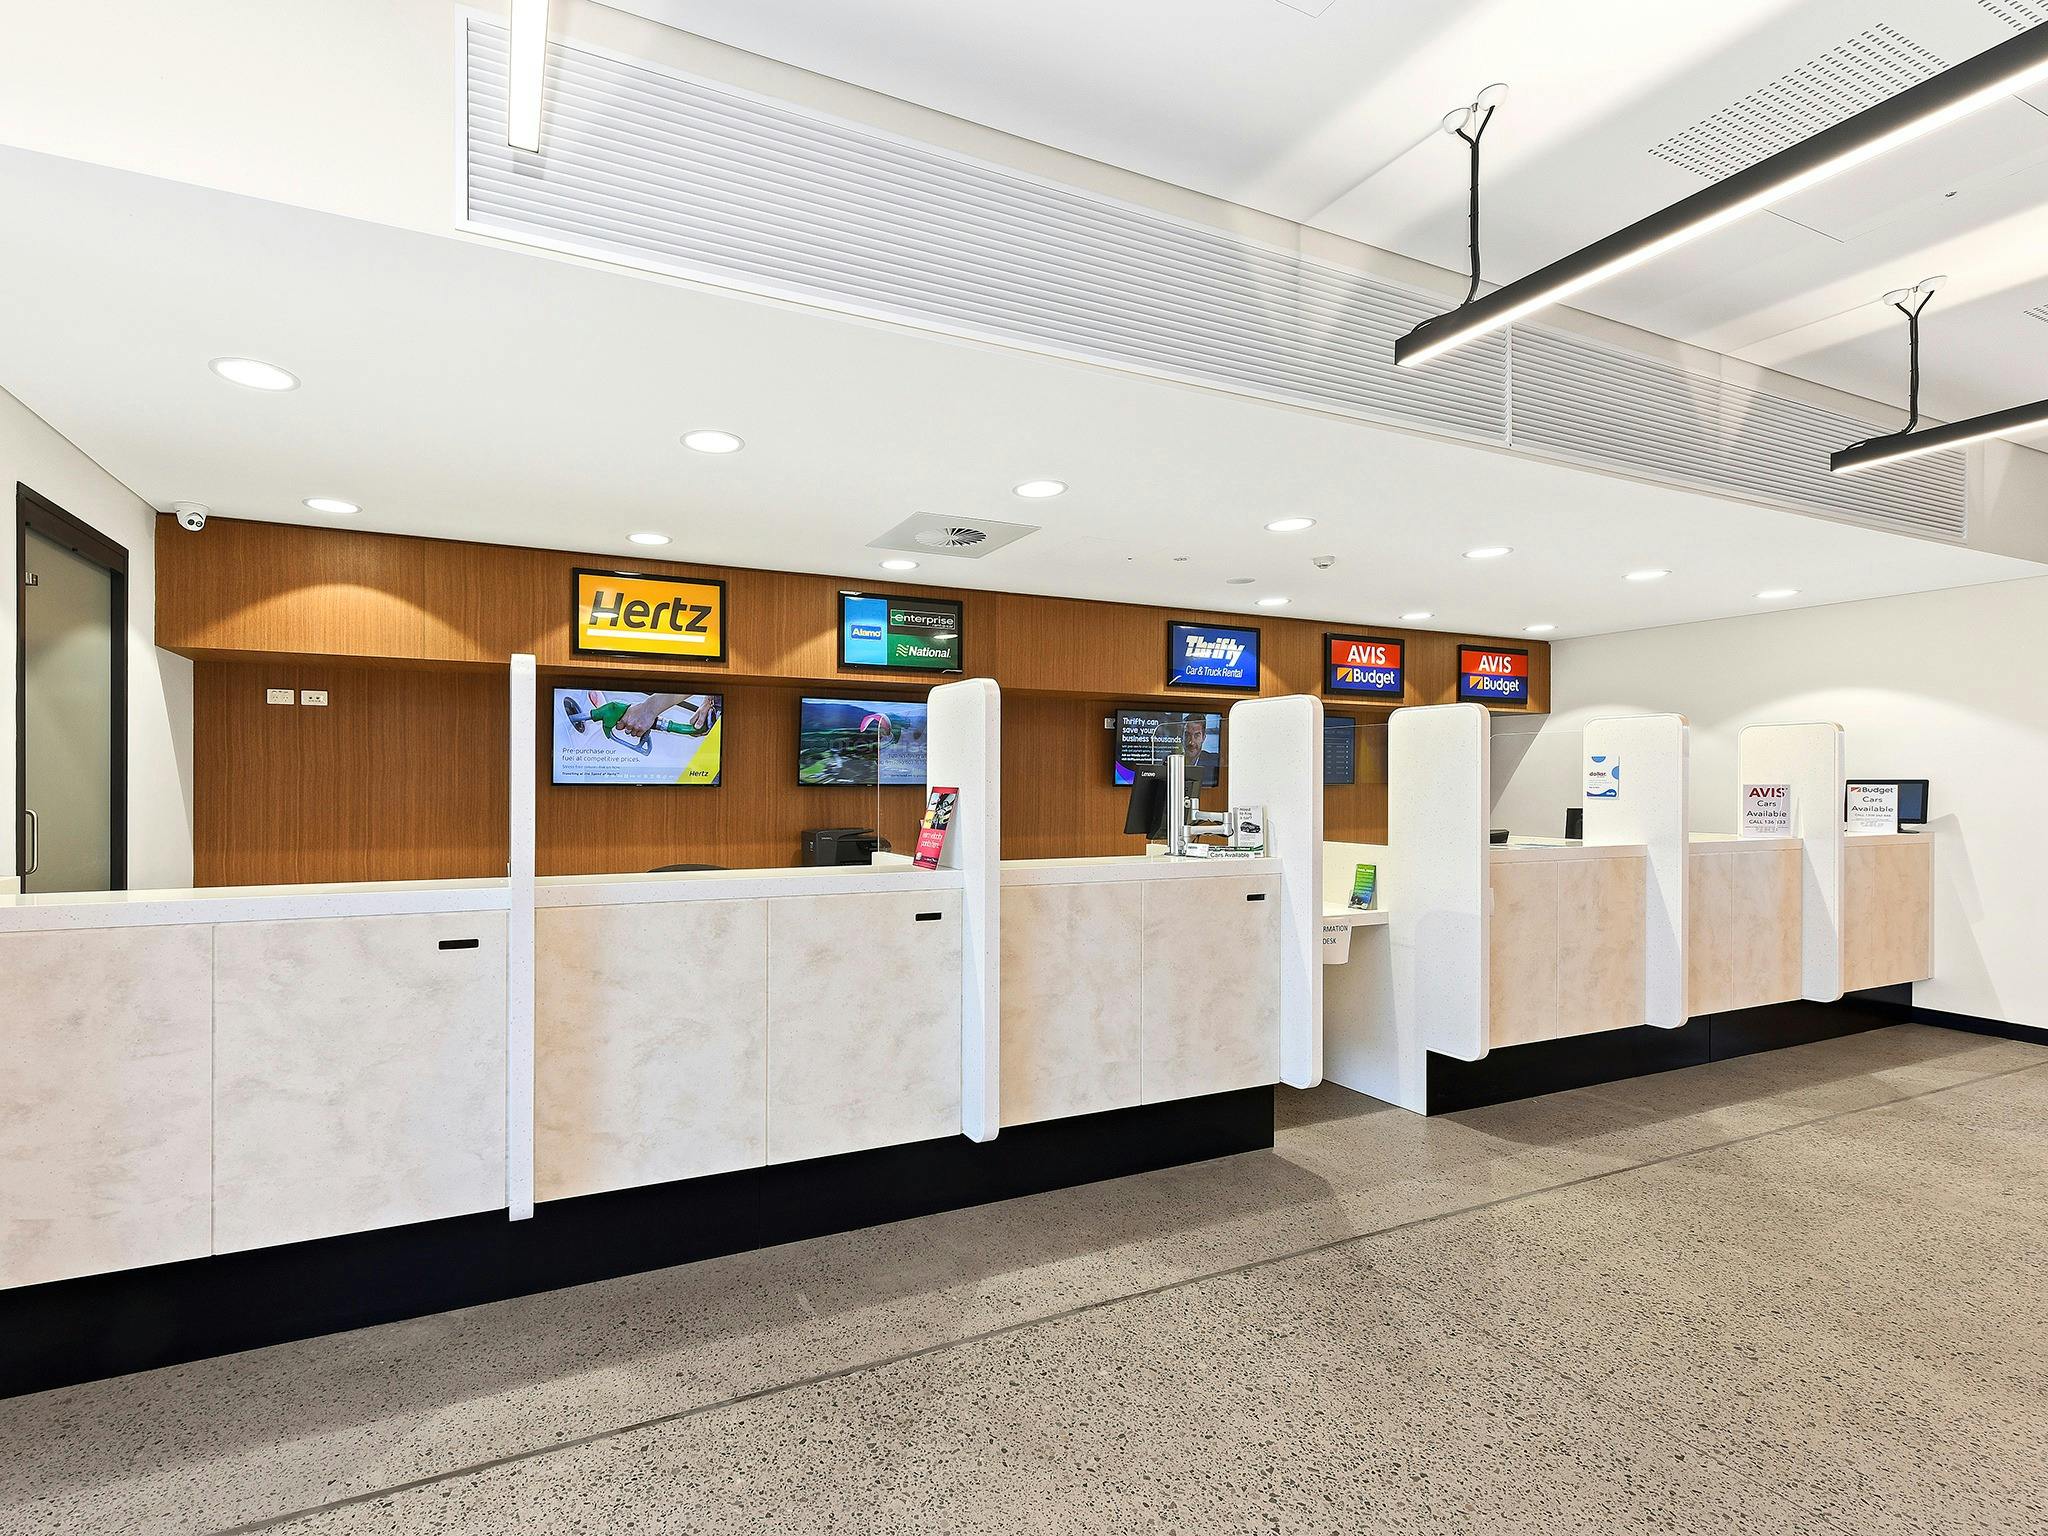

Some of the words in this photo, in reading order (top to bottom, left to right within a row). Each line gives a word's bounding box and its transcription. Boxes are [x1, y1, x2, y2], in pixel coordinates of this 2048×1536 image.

[589, 591, 712, 633] Hertz
[893, 613, 954, 626] enterprise
[852, 627, 881, 637] Alamo
[908, 646, 951, 658] National
[1185, 635, 1246, 668] Thrifty
[1346, 644, 1387, 665] AVIS
[1478, 655, 1512, 674] AVIS
[1185, 665, 1198, 675] Car
[1197, 666, 1204, 676] &
[1204, 666, 1222, 677] Truck
[1222, 667, 1244, 678] Rental
[1353, 668, 1395, 689] Budget
[1483, 676, 1520, 696] Budget
[1122, 717, 1146, 727] Thrifty
[1122, 734, 1150, 742] business
[1150, 735, 1182, 743] thousands
[562, 747, 605, 755] Pre-purchase
[688, 769, 709, 777] Hertz
[1748, 787, 1786, 798] AVIS
[1862, 786, 1894, 795] Budget
[1756, 799, 1777, 807] Cars
[1322, 937, 1337, 945] DESK
